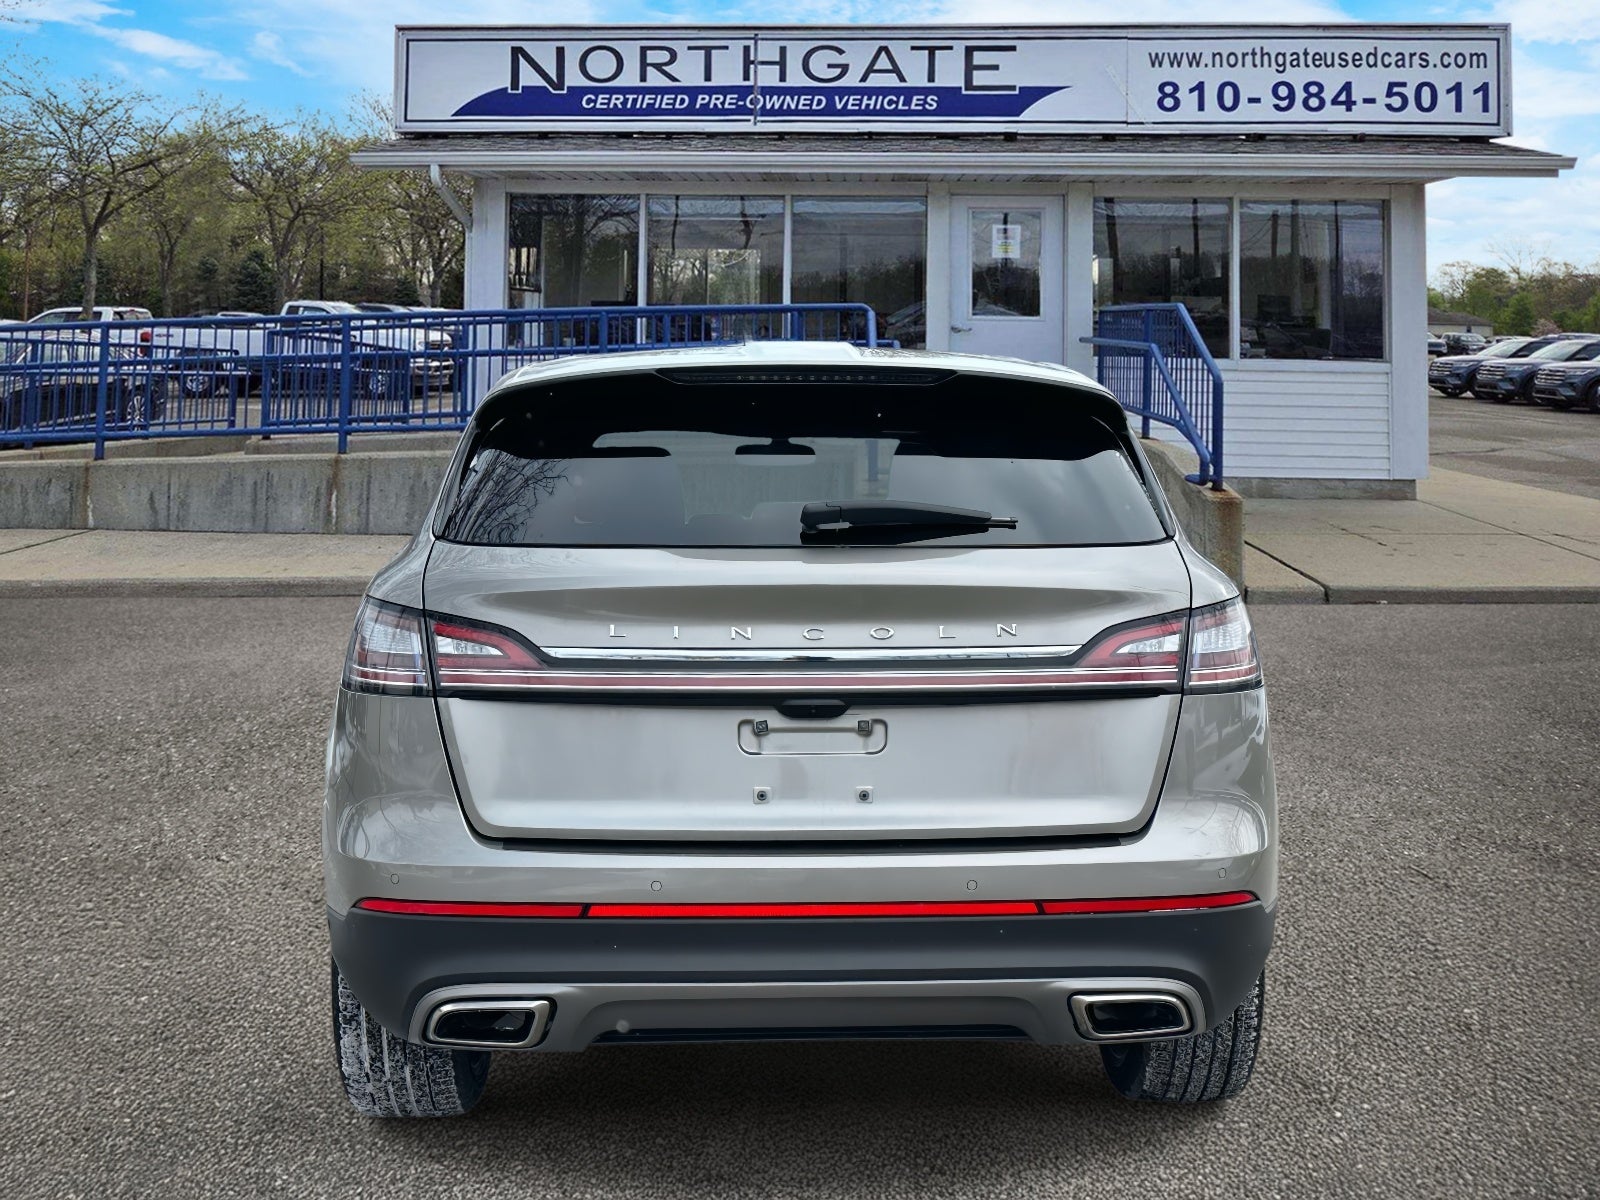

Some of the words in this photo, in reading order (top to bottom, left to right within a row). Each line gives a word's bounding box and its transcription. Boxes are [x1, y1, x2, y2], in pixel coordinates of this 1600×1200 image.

[510, 45, 1017, 92] NORTHGATE
[1148, 46, 1488, 73] www.northgateusedcars.com
[581, 94, 689, 109] CERTIFIED
[695, 94, 826, 110] PRE-OWNED
[834, 95, 938, 110] VEHICLES
[1156, 80, 1491, 113] 810-984-5011
[609, 623, 1018, 640] LINCOLN
